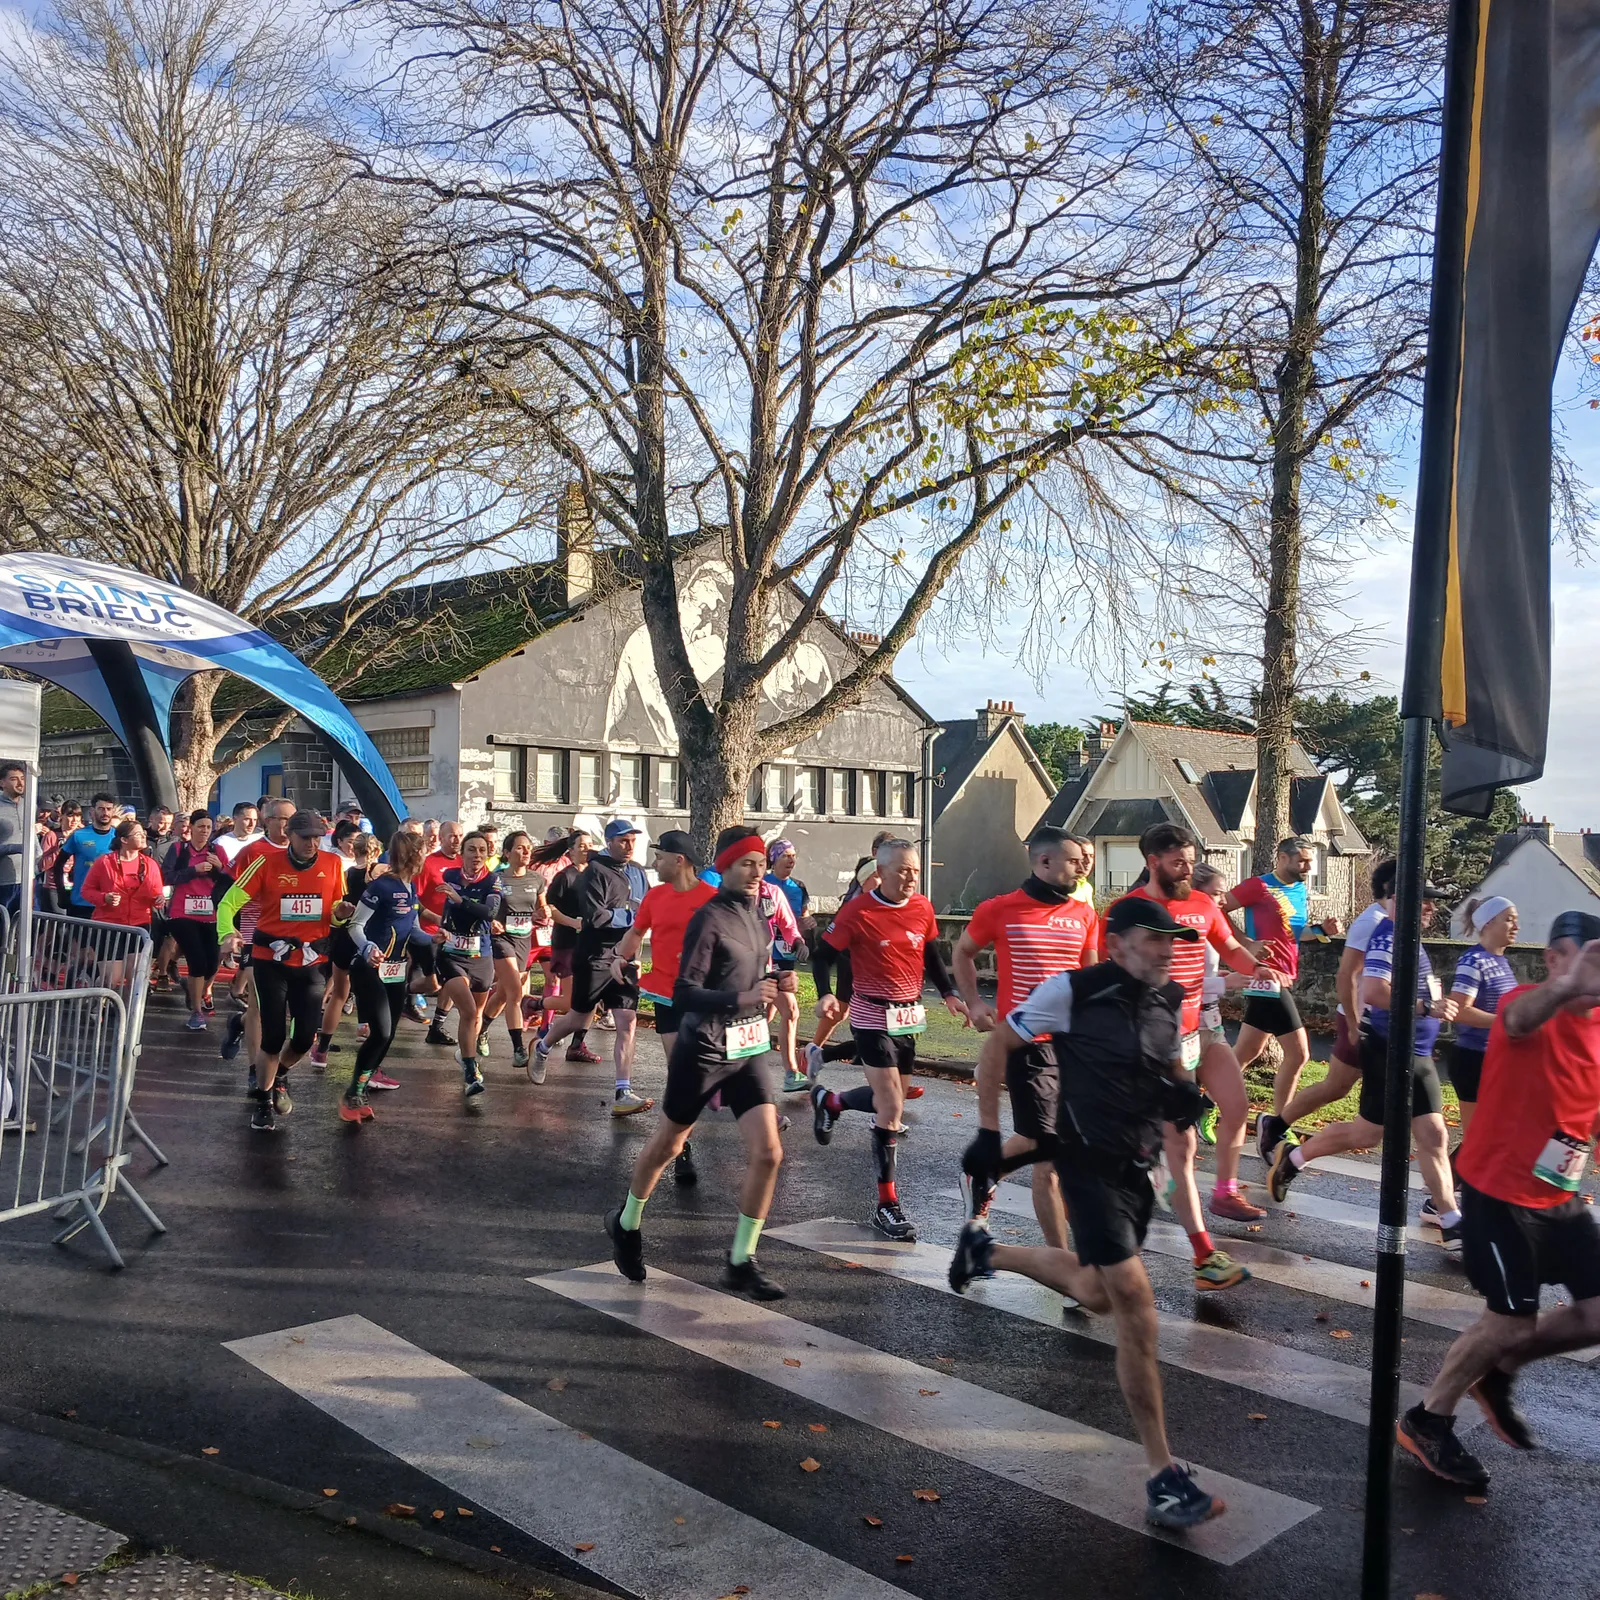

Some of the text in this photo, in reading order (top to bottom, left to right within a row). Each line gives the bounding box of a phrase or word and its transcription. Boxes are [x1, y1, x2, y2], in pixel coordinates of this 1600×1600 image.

[13, 574, 180, 610] SAINT
[22, 592, 192, 628] BRIEUC
[30, 611, 197, 636] NOUS RAPPROCHE
[192, 899, 207, 910] 341
[291, 899, 312, 914] 415
[896, 1007, 918, 1026] 426
[738, 1023, 761, 1047] 340
